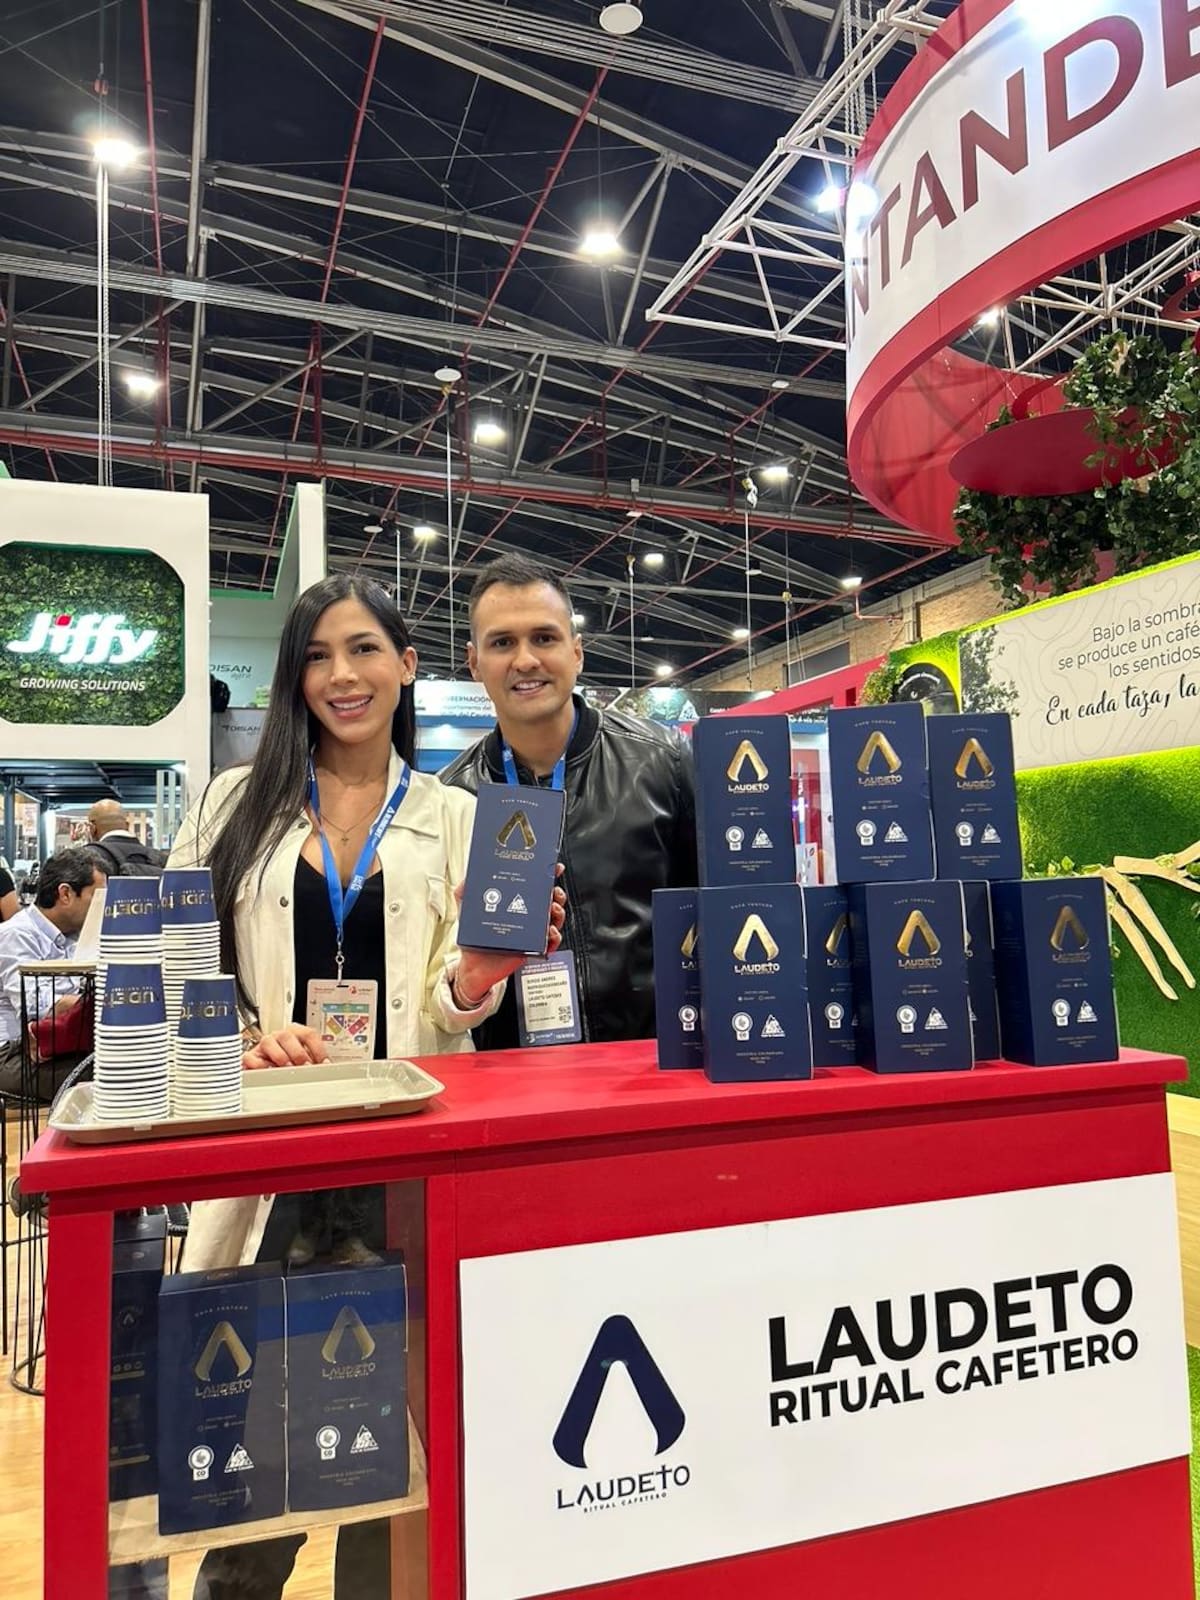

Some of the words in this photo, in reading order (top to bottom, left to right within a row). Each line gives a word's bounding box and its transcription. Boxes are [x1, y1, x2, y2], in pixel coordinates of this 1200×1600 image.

[6, 612, 158, 664] Jiffy
[1093, 622, 1125, 642] Bajo
[1128, 617, 1141, 632] la
[1058, 656, 1074, 670] se
[1077, 640, 1137, 669] produce
[1141, 634, 1161, 649] un
[1166, 620, 1200, 643] café
[1109, 663, 1130, 678] los
[1133, 646, 1200, 673] sentidos
[20, 677, 79, 690] GROWING
[80, 679, 146, 692] SOLUTIONS
[1046, 695, 1070, 725] En
[1078, 690, 1117, 719] cada
[1122, 685, 1170, 718] taza,
[1179, 673, 1198, 699] la
[728, 782, 770, 792] LAUDETO
[734, 962, 781, 973] LAUDETO
[897, 956, 943, 967] LAUDETO
[767, 1263, 1134, 1383] LAUDETO
[321, 1361, 376, 1379] LAUDETO
[769, 1368, 925, 1427] RITUAL
[935, 1328, 1139, 1395] CAFETERO
[195, 1378, 253, 1397] LAUDETO
[557, 1464, 690, 1509] LAUDETO
[584, 1502, 616, 1514] RITUAL
[621, 1492, 667, 1507] CAFETERO
